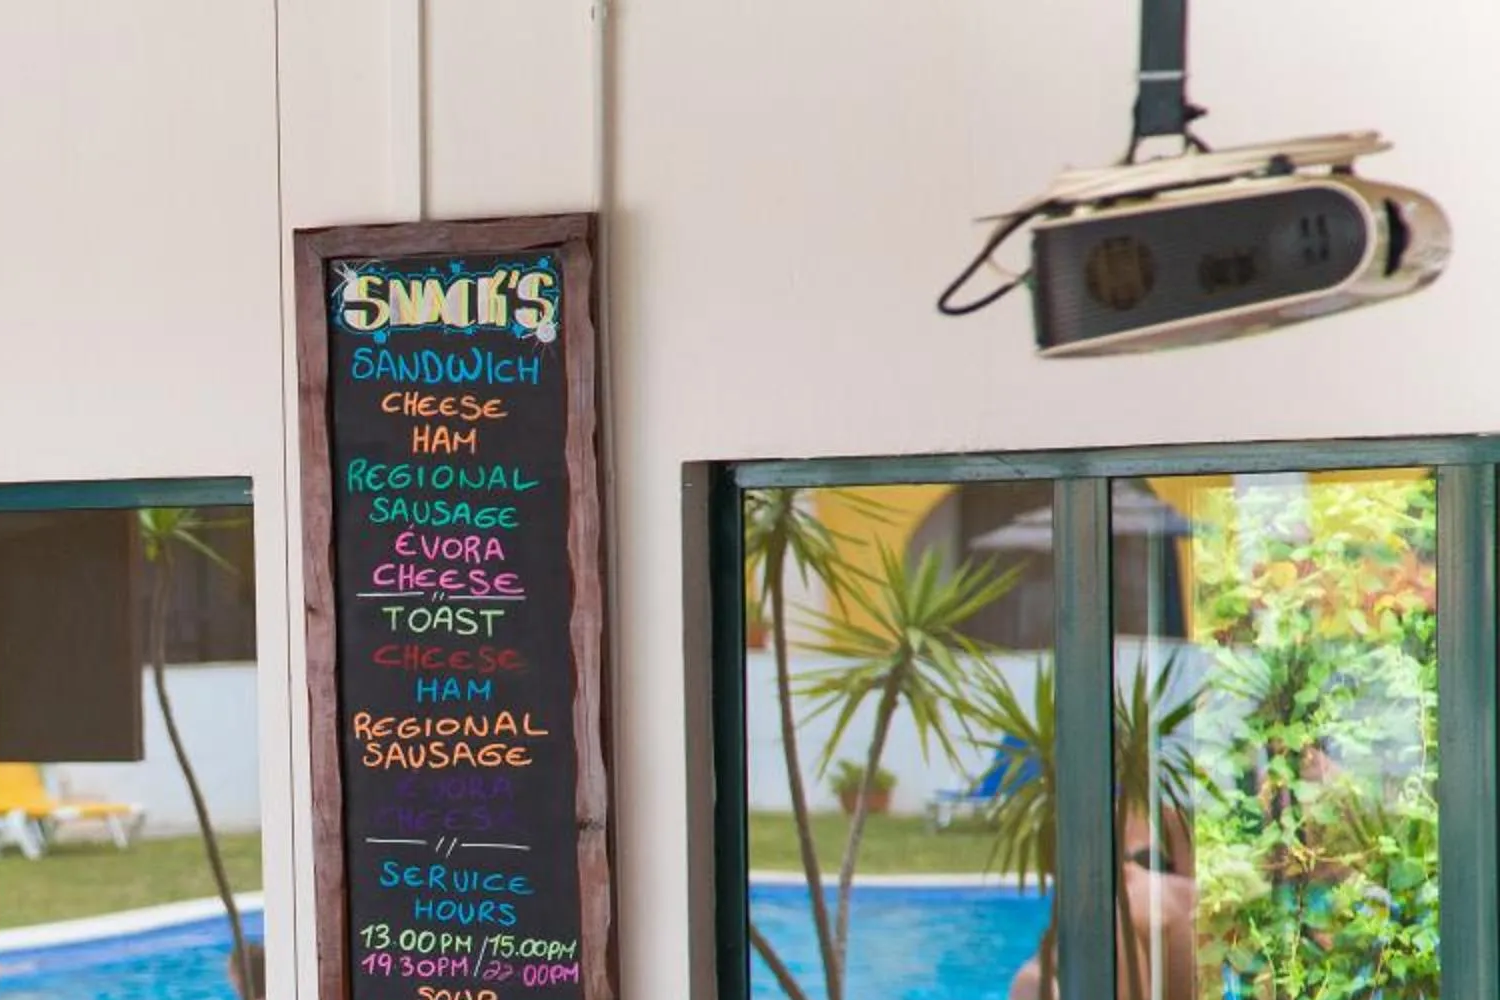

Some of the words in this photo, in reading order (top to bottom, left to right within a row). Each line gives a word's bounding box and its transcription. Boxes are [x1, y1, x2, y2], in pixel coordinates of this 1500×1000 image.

[351, 347, 540, 386] SANDWICH
[380, 391, 508, 420] CHEESE
[411, 424, 477, 455] HAM
[347, 457, 540, 493] REGIONAL
[368, 497, 520, 529] SAUSAGE
[373, 563, 525, 596] CHEESE
[381, 606, 505, 637] TOAST
[371, 644, 527, 674] CHEESE
[416, 676, 492, 703] HAM
[353, 710, 549, 740] REGIONAL
[362, 741, 533, 770] SAUSAGE
[379, 860, 536, 896] SERVICE
[414, 898, 518, 927] HOURS
